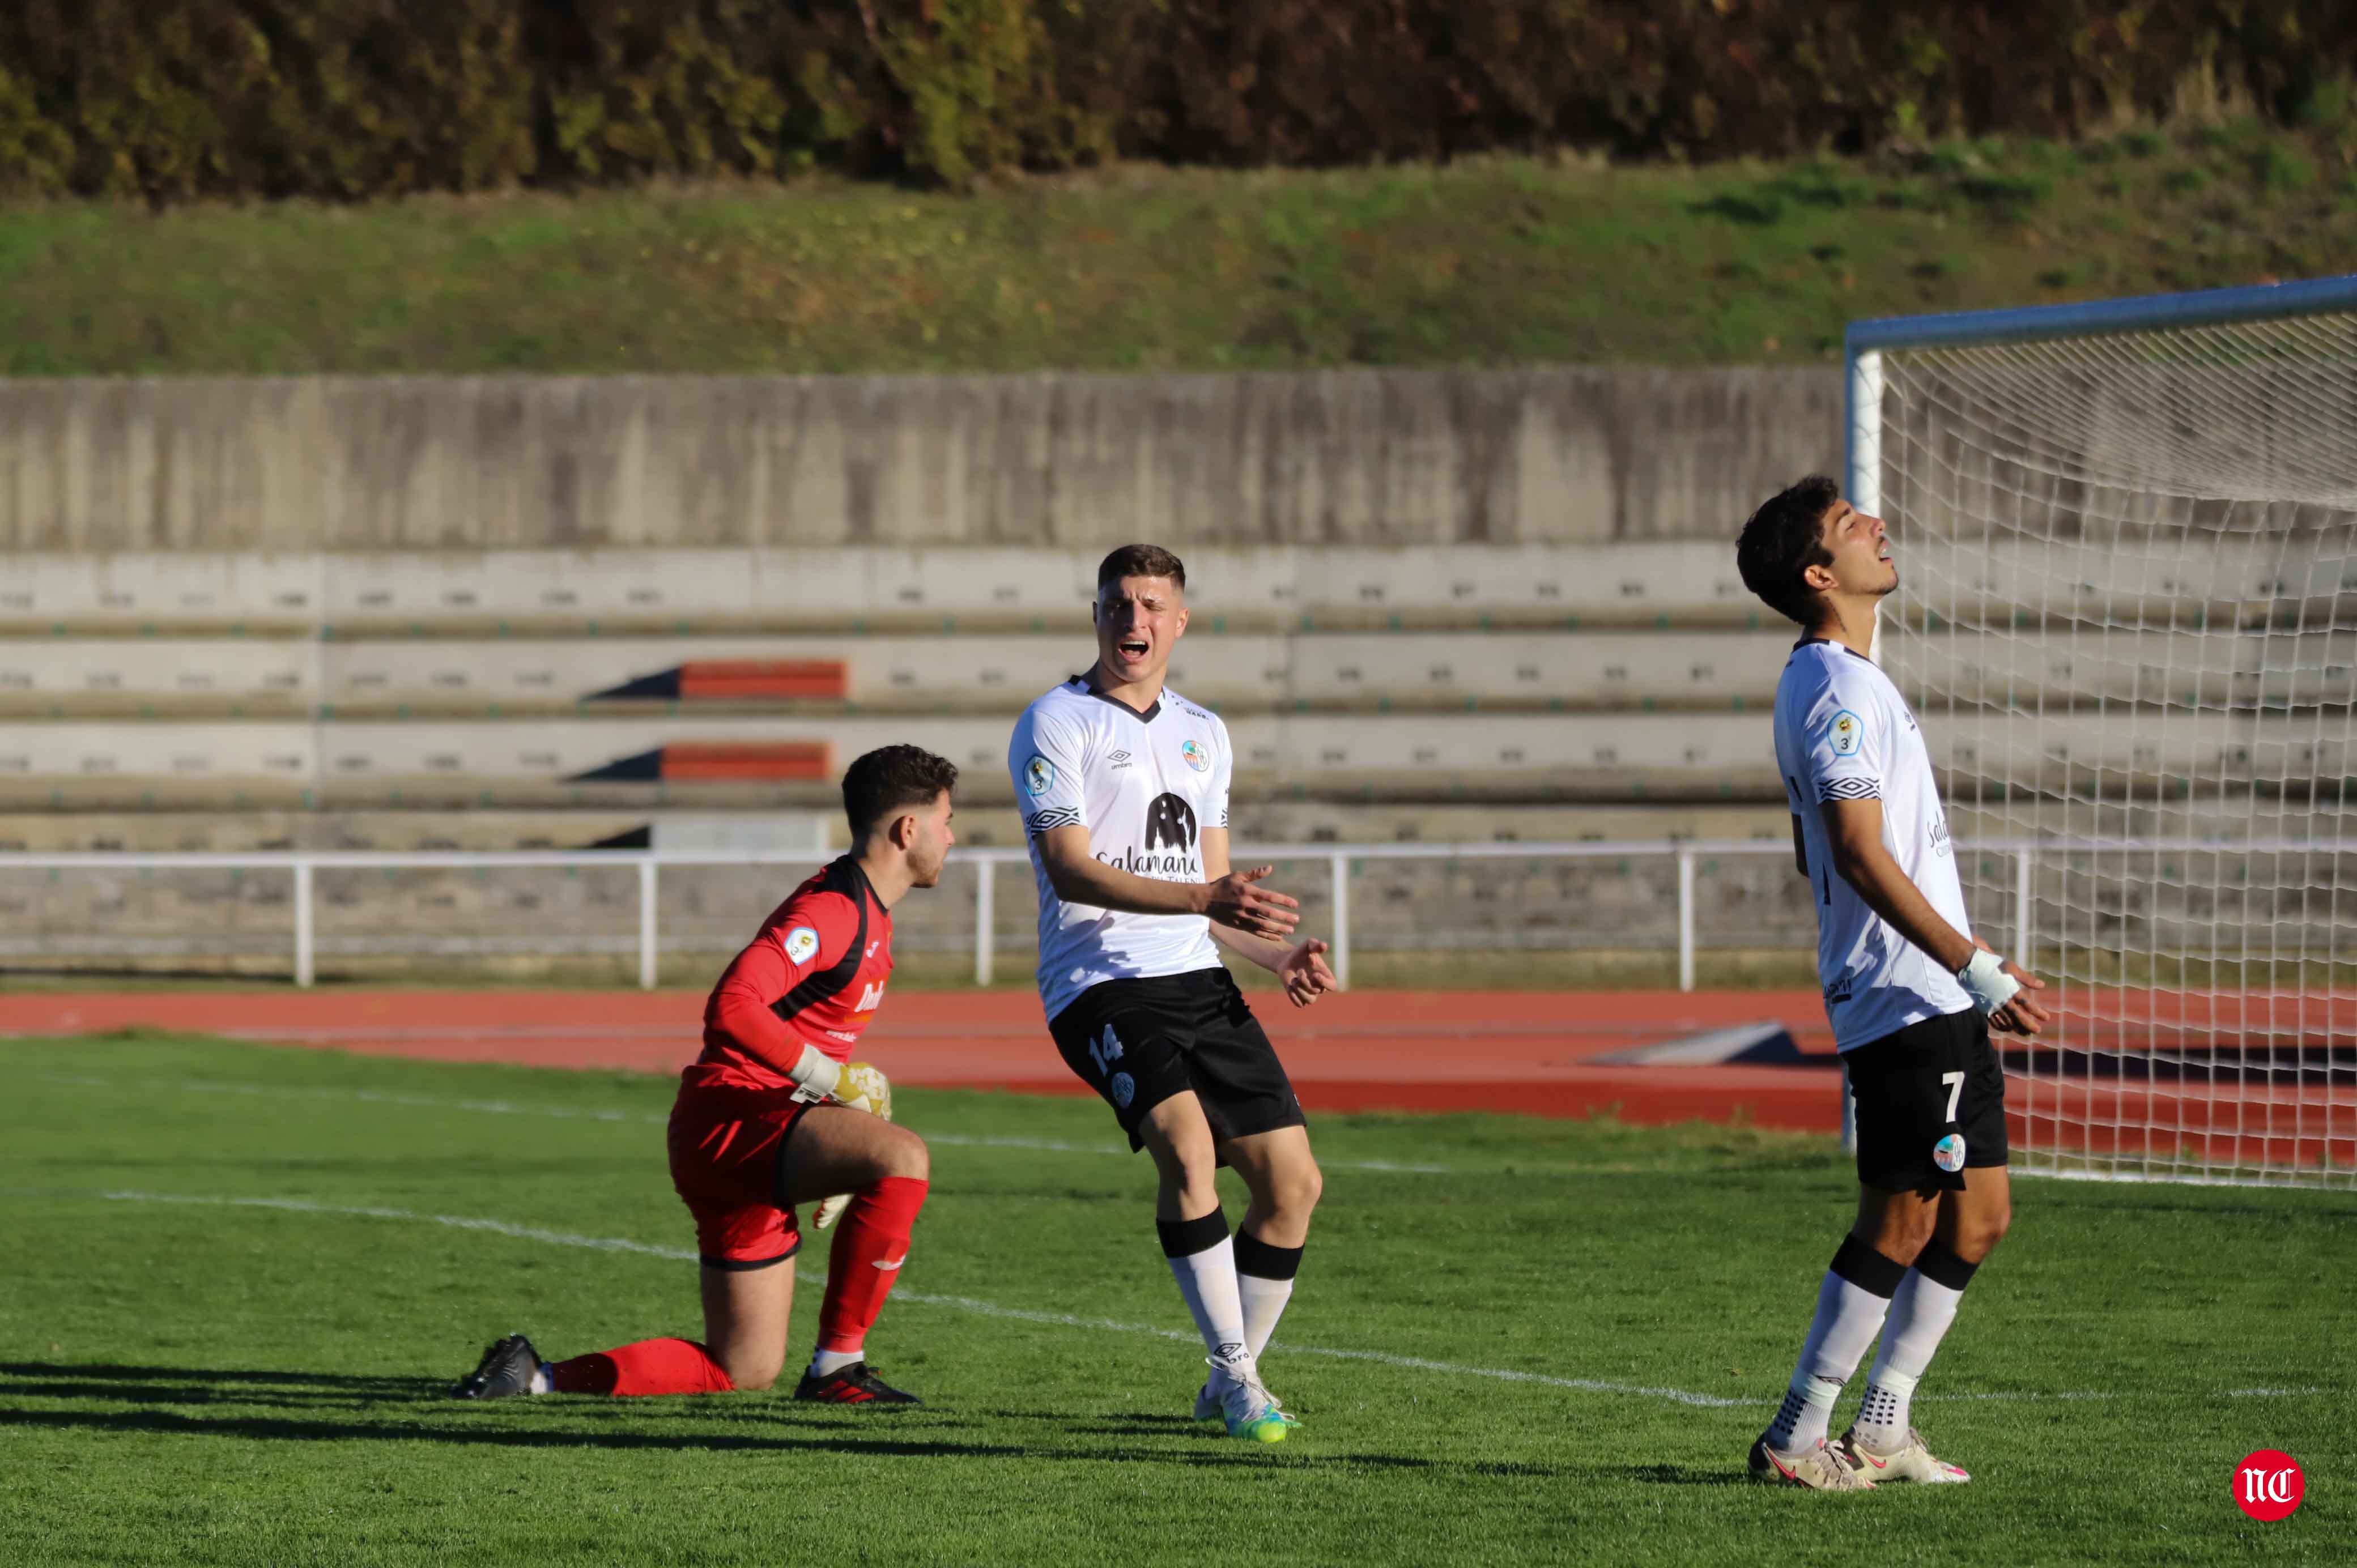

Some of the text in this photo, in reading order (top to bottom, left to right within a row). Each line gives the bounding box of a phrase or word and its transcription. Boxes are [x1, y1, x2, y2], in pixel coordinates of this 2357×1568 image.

[1841, 738, 1849, 750] 3
[1035, 779, 1043, 790] 3
[790, 946, 799, 957] 3
[1088, 1024, 1124, 1076] 14
[1942, 1071, 1965, 1123] 7
